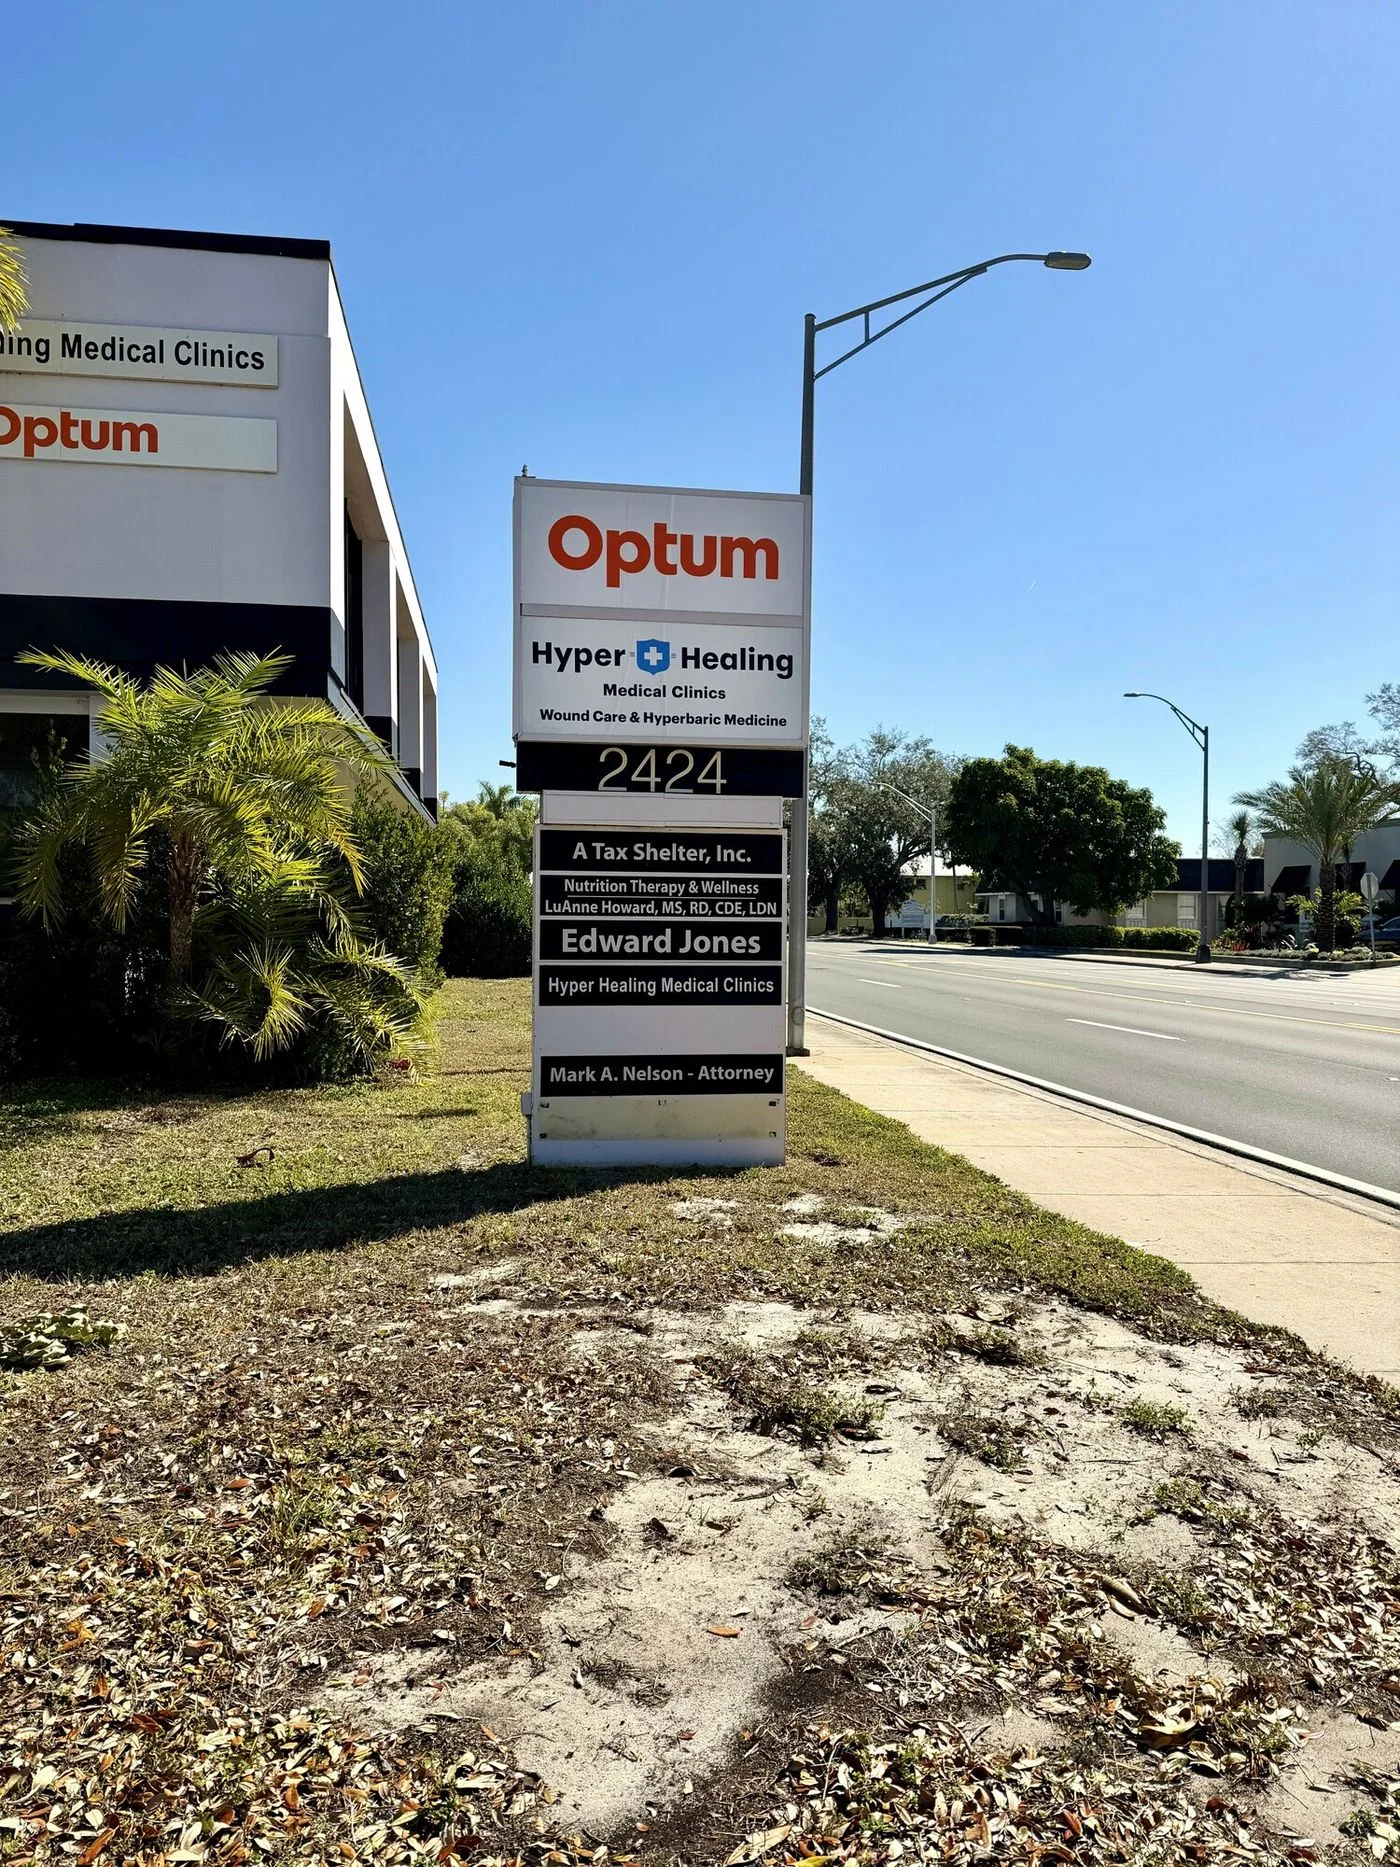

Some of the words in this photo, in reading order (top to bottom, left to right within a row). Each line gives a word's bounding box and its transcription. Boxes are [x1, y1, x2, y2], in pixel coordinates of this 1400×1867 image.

[61, 333, 164, 364] Medical
[174, 340, 265, 370] Clinics
[548, 515, 779, 588] Optum
[532, 641, 626, 673] Hyper
[681, 646, 794, 680] Healing
[603, 683, 667, 698] Medical
[671, 685, 727, 699] Clinics
[539, 709, 590, 722] Wound
[592, 710, 627, 723] Care
[629, 712, 640, 723] &
[643, 712, 721, 726] Hyperbaric
[724, 714, 787, 727] Medicine
[598, 747, 727, 794] 2424
[572, 842, 588, 860] A
[592, 843, 628, 861] Tax
[633, 843, 711, 864] Shelter,
[716, 845, 752, 863] Inc.
[564, 879, 627, 893] Nutrition
[630, 880, 685, 896] Therapy
[688, 880, 699, 894] &
[701, 881, 759, 894] Wellness
[545, 900, 598, 913] LuAnne
[601, 901, 658, 916] Howard,
[662, 902, 686, 916] MS,
[689, 902, 712, 916] RD,
[715, 902, 746, 916] CDE,
[749, 902, 777, 915] LDN
[562, 927, 672, 953] Edward
[679, 930, 761, 954] Jones
[548, 977, 594, 996] Hyper
[599, 977, 656, 996] Healing
[661, 977, 719, 993] Medical
[723, 977, 774, 993] Clinics
[550, 1067, 596, 1082] Mark
[600, 1067, 618, 1082] A.
[623, 1066, 683, 1081] Nelson
[698, 1065, 774, 1083] Attorney
